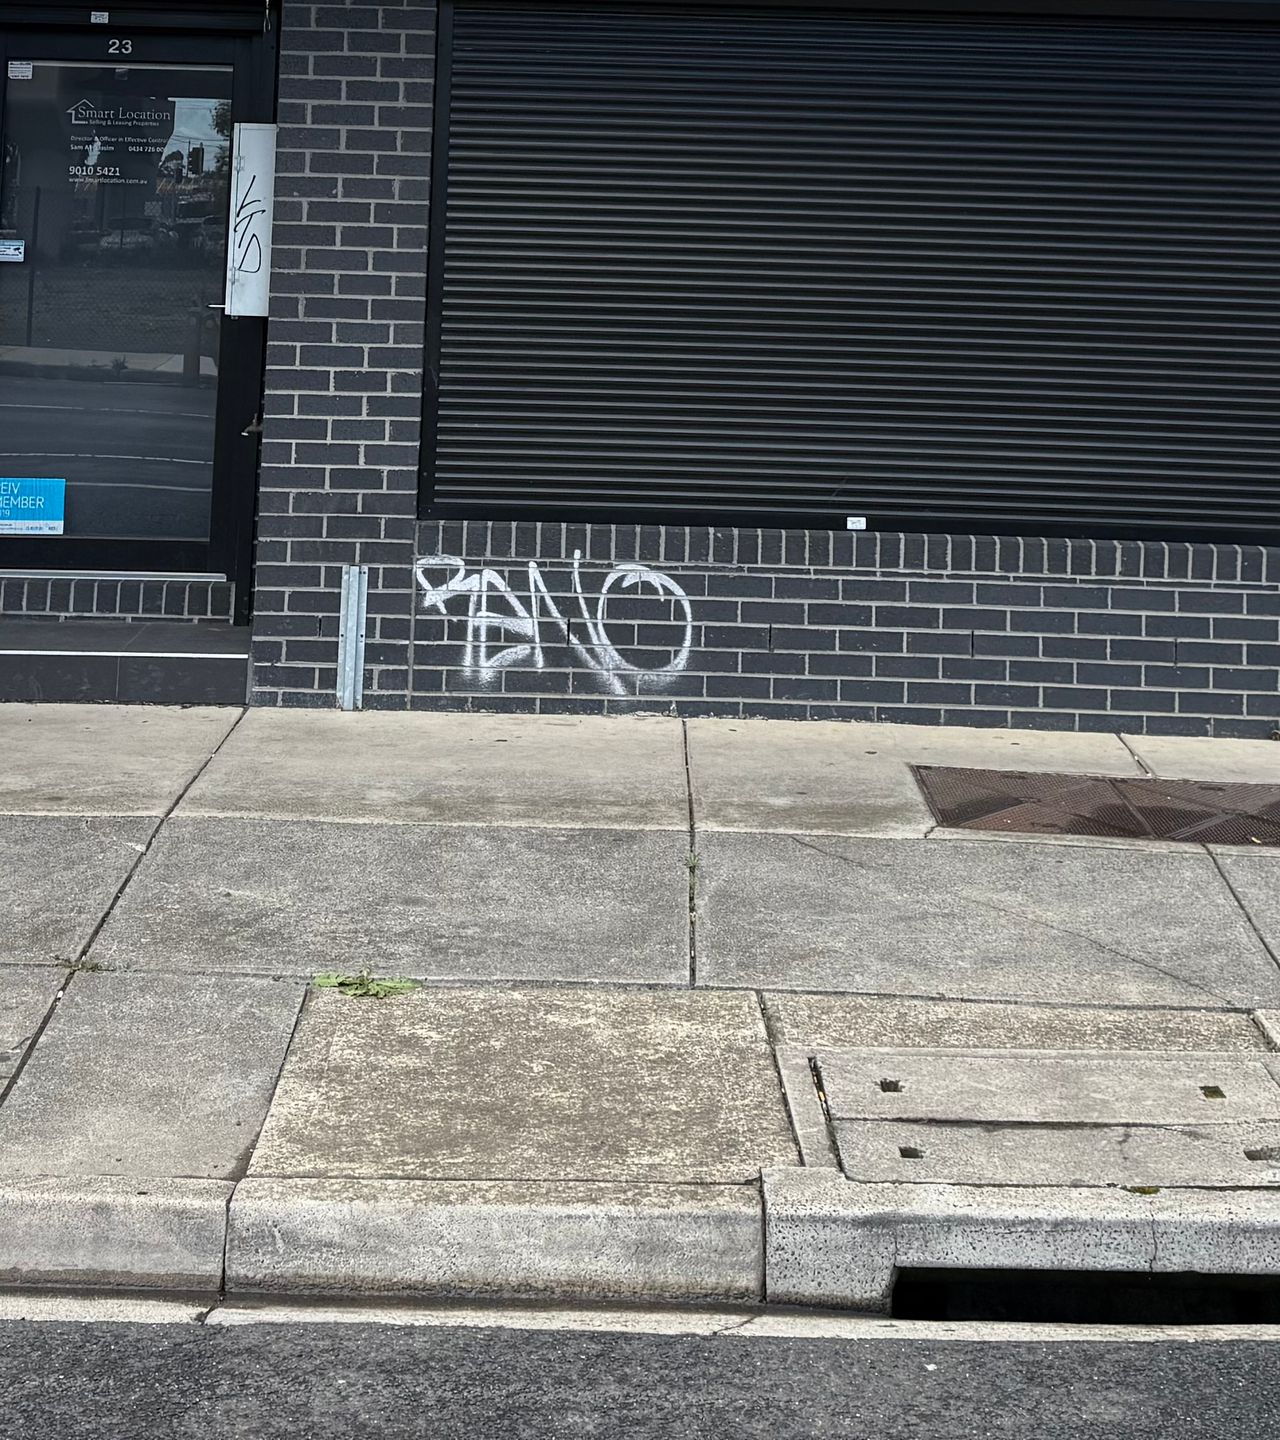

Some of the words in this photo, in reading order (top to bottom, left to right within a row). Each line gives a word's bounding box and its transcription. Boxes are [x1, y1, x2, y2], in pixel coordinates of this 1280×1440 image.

[108, 39, 133, 54] 23
[78, 105, 115, 119] Smart
[119, 107, 171, 120] Location
[69, 166, 94, 175] 9010
[96, 166, 120, 176] 5421
